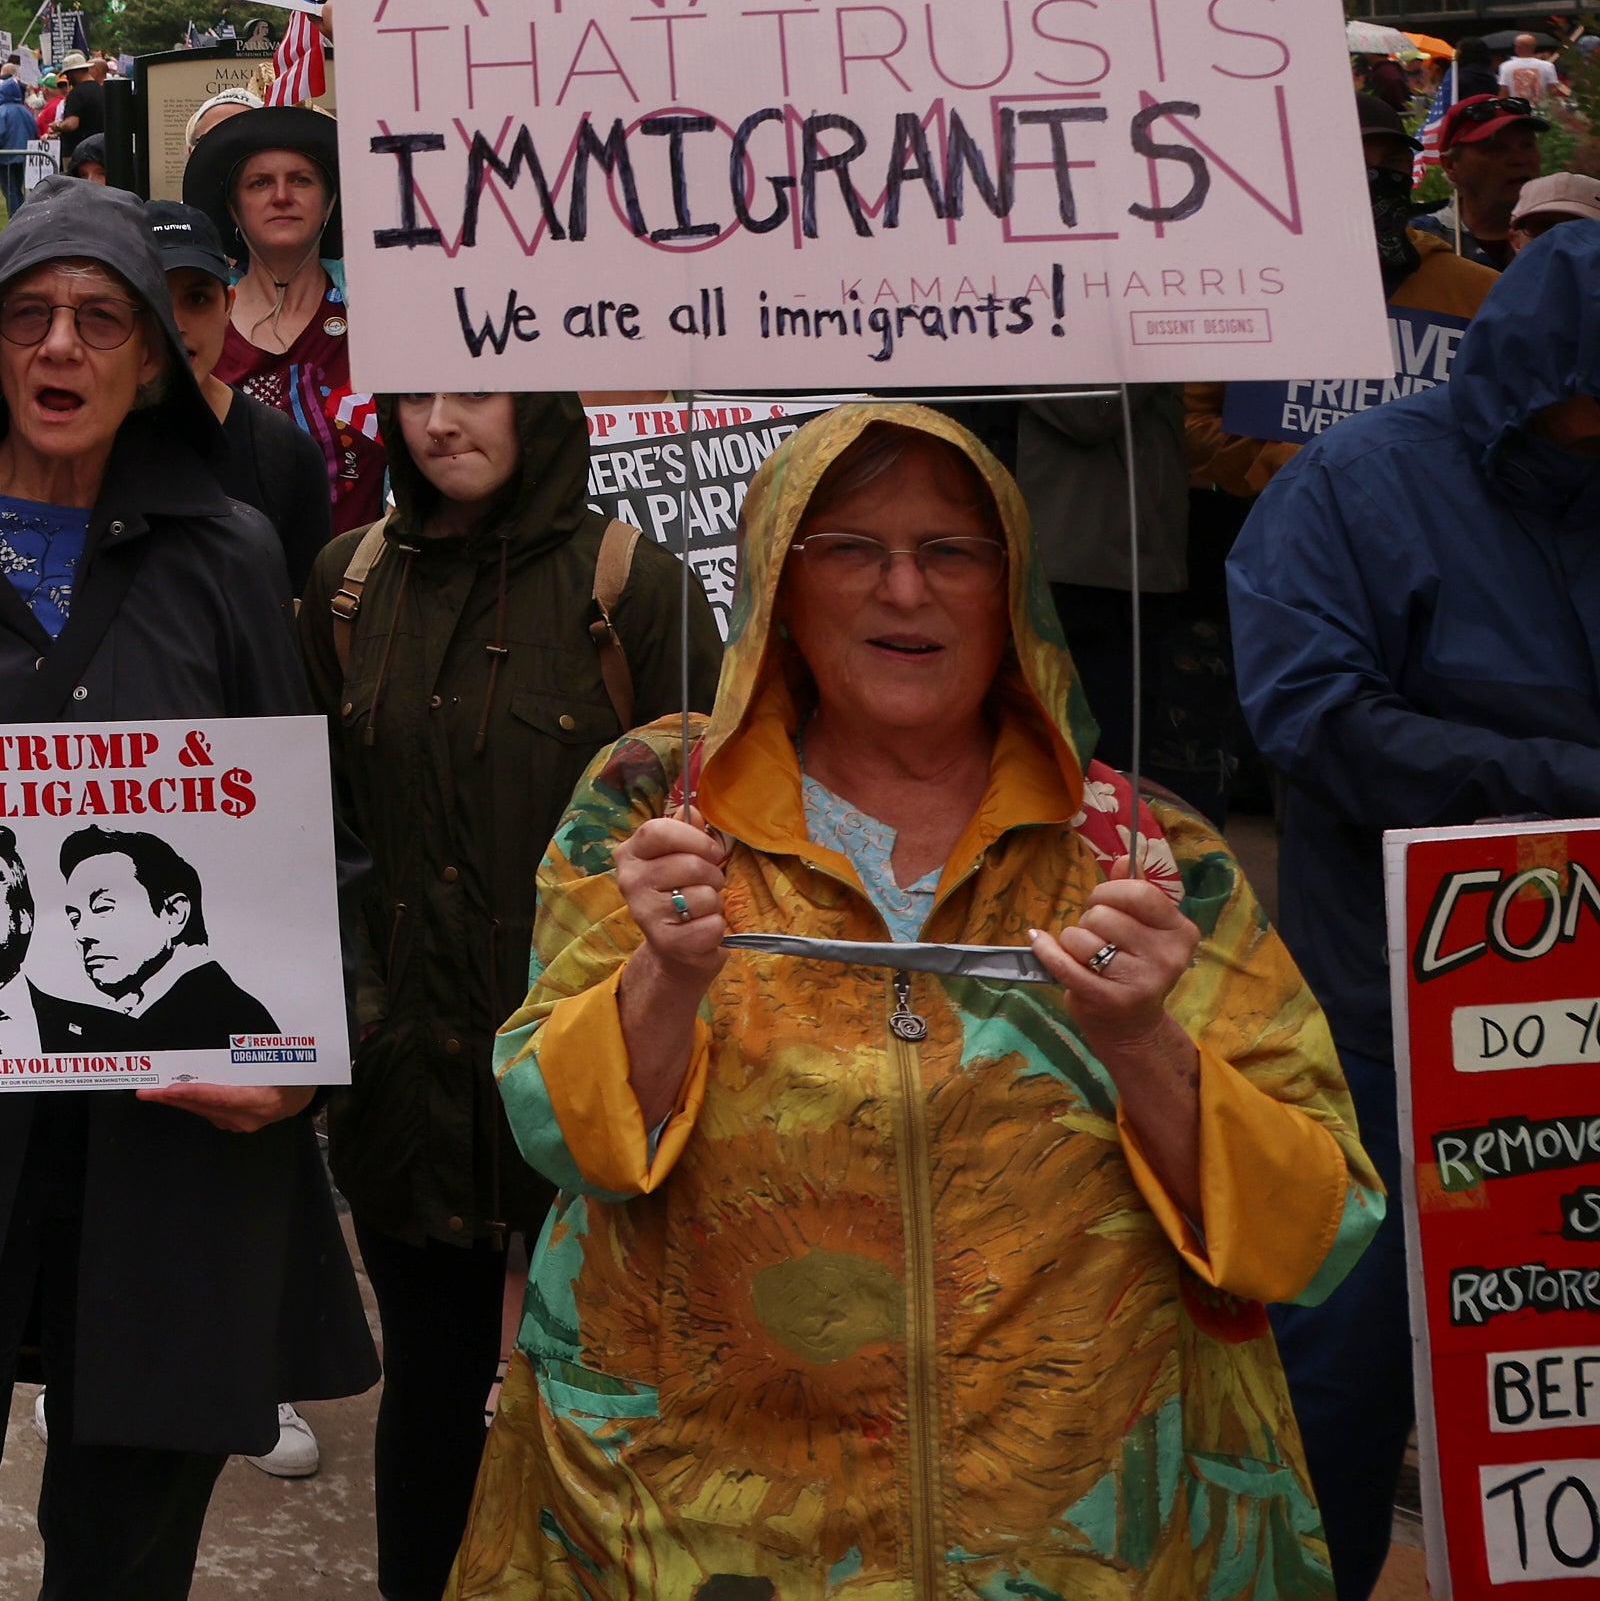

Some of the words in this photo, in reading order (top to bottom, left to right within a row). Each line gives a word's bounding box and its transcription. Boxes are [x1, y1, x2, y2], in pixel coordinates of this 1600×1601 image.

[376, 12, 707, 112] THAT
[29, 154, 51, 167] KING
[36, 142, 50, 152] NO
[369, 100, 1211, 250] IMMIGRANTS
[164, 223, 192, 232] unwell
[841, 273, 1050, 305] KAMALA
[1083, 267, 1286, 298] HARRIS
[454, 285, 541, 358] We
[563, 297, 640, 340] are
[668, 285, 727, 340] all
[759, 263, 1066, 362] immigrants!
[1146, 320, 1195, 337] DISSENT
[1203, 318, 1255, 336] DESIGNS
[629, 405, 752, 436] TRUMP
[178, 730, 216, 766] &
[253, 1036, 315, 1048] REVOLUTION
[1480, 1014, 1545, 1058] DO
[1566, 1001, 1600, 1055] Y
[233, 1050, 278, 1063] ORGANIZE
[281, 1050, 293, 1061] TO
[294, 1049, 315, 1062] WIN
[1486, 1467, 1600, 1570] TO
